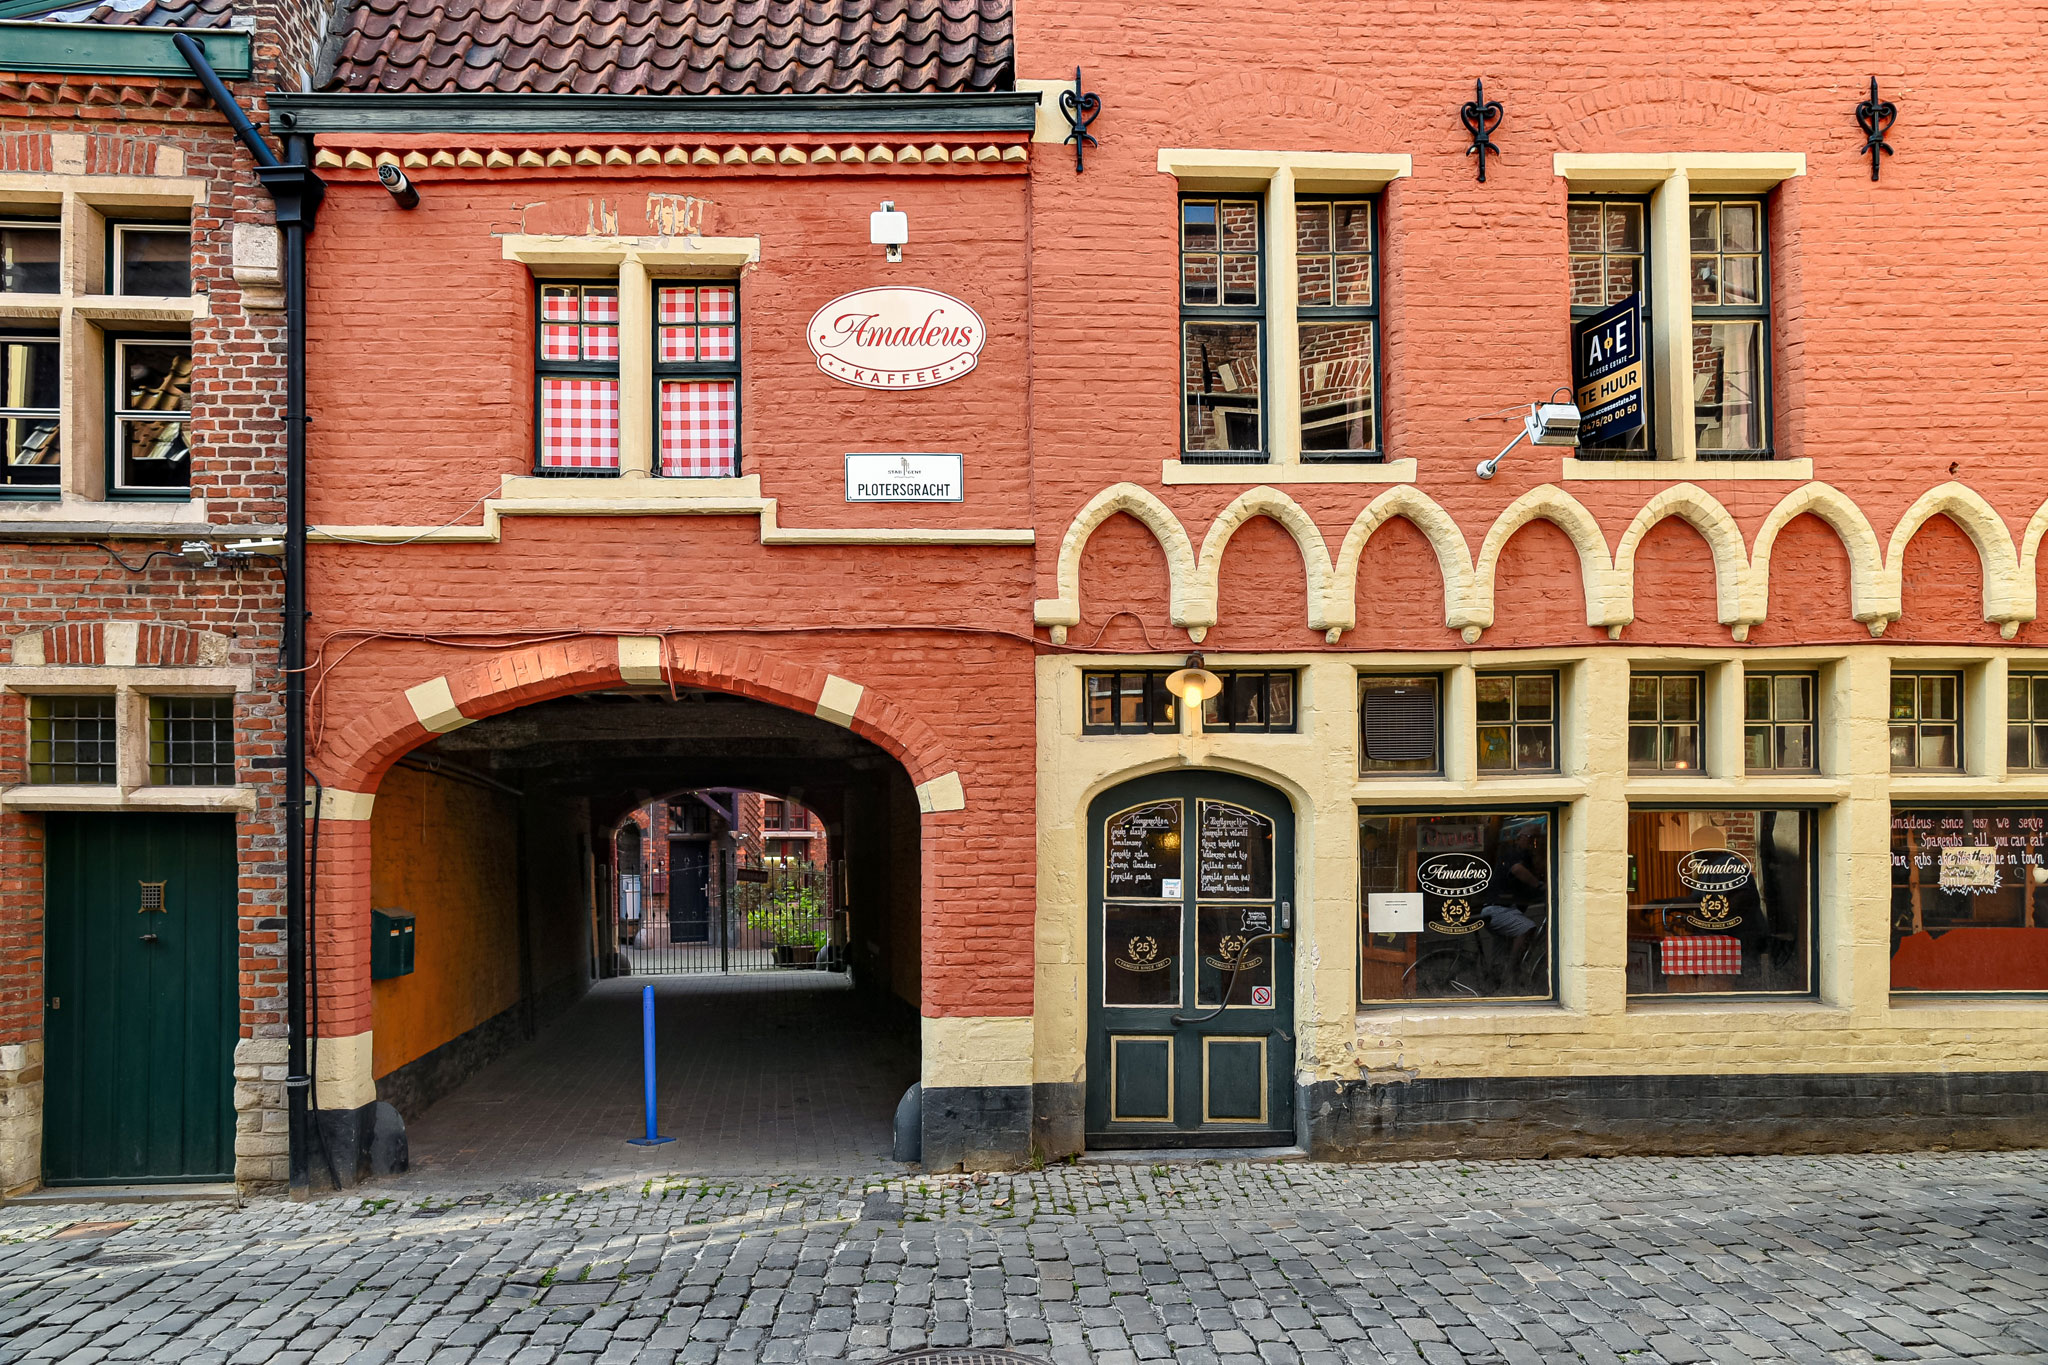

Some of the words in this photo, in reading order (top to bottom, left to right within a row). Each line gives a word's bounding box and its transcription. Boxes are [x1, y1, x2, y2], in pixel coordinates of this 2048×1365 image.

[819, 309, 973, 348] Amadeus
[1589, 364, 1609, 378] ACCESS
[1610, 355, 1628, 369] ESTATE
[854, 368, 942, 385] KAFFEE
[1581, 387, 1597, 406] TE
[1600, 370, 1637, 398] HUUR
[1581, 393, 1637, 421] www.accessestate.be
[1581, 413, 1613, 433] 0475/20
[1614, 408, 1625, 420] 00
[1627, 403, 1638, 415] 50
[858, 483, 951, 496] PLOTERSGRACHT
[1941, 817, 1964, 829] since
[1972, 818, 1989, 829] 1987
[2018, 817, 2044, 832] serve
[1994, 836, 2008, 850] you
[2010, 836, 2027, 847] can
[1682, 857, 1747, 875] Amadeus
[1914, 852, 1932, 869] ribs
[2007, 854, 2017, 865] in
[2021, 851, 2044, 865] town
[1422, 862, 1488, 880] Amadeus
[1436, 887, 1474, 896] KAFFEE
[1696, 882, 1734, 890] KAFFEE
[1449, 905, 1463, 915] 25
[1708, 900, 1721, 910] 25
[1136, 942, 1150, 952] 25
[1227, 941, 1240, 951] 25
